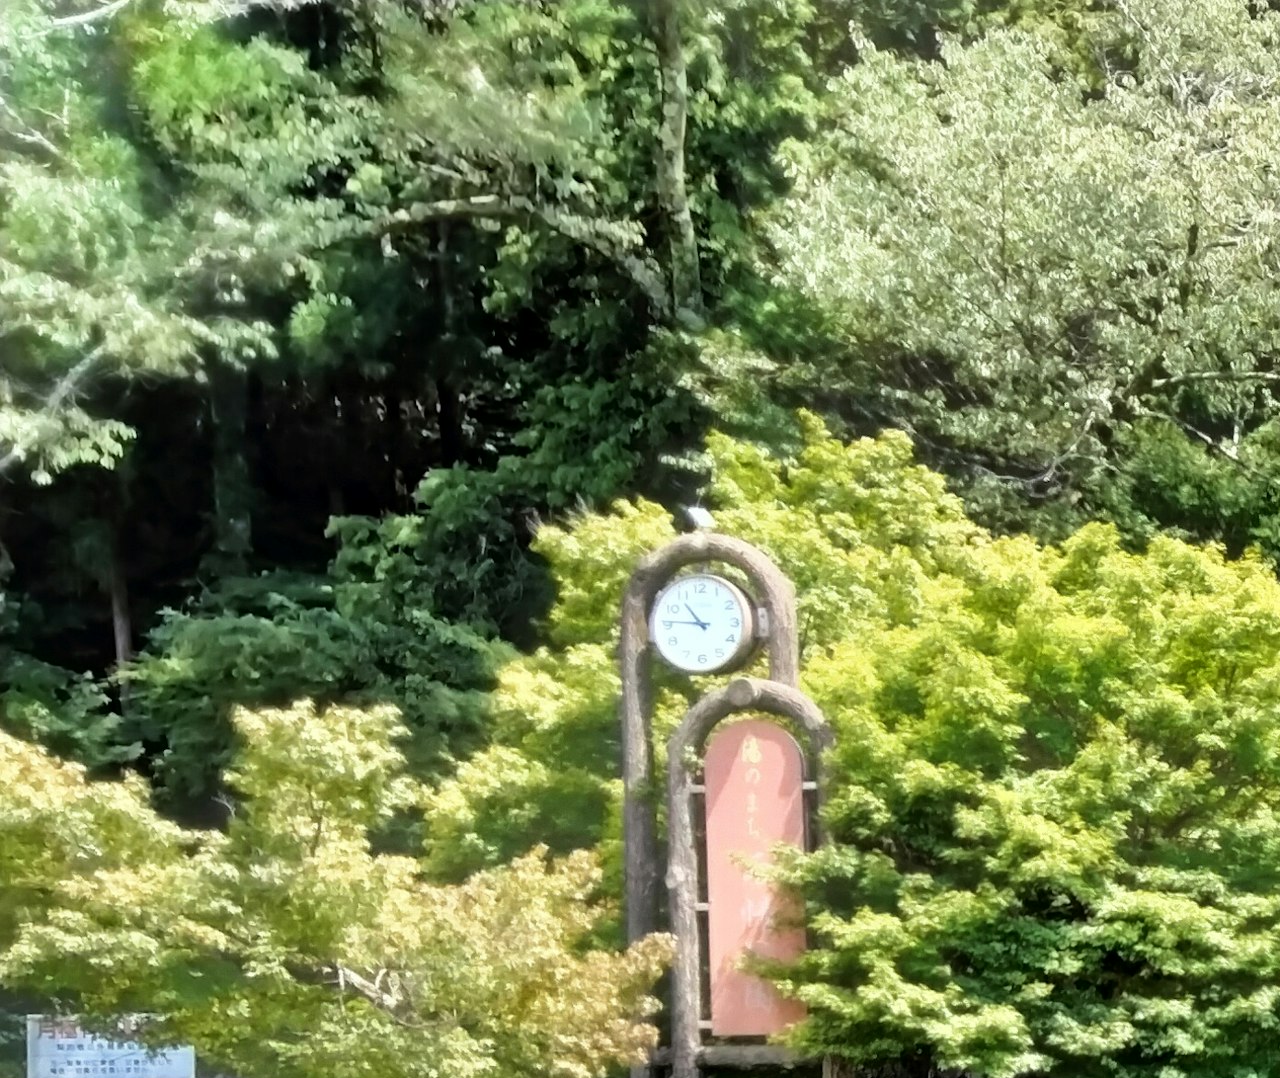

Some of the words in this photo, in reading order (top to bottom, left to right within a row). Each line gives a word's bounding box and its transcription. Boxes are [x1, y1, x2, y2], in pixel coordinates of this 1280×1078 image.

[694, 583, 707, 594] 12
[715, 587, 719, 597] 1
[678, 590, 688, 600] 11
[667, 604, 680, 614] 10
[724, 600, 734, 610] 2
[662, 620, 673, 630] 9
[730, 617, 740, 628] 3
[668, 636, 678, 646] 8
[725, 634, 736, 643] 4
[682, 650, 690, 658] 7
[714, 648, 724, 658] 5
[697, 654, 708, 664] 6
